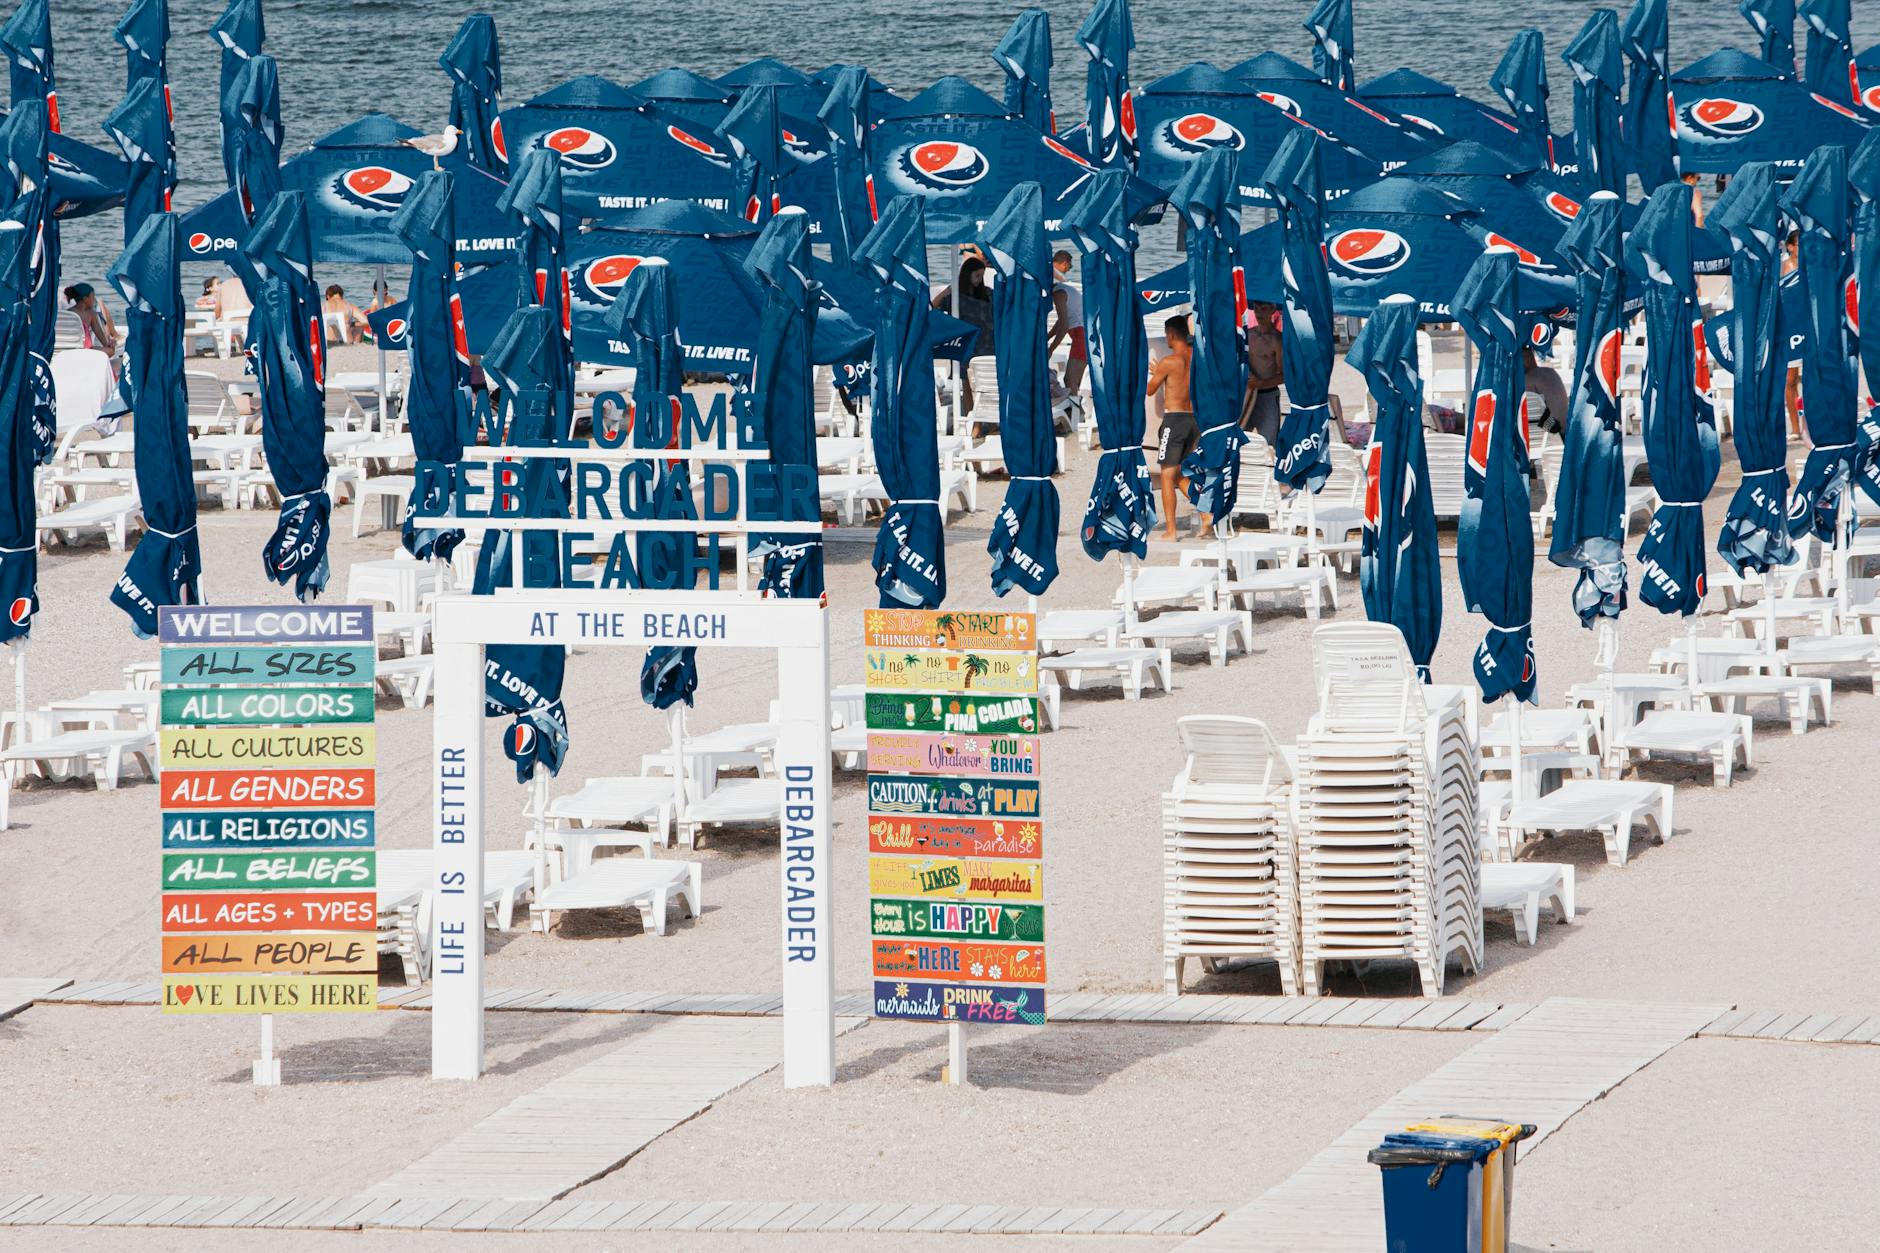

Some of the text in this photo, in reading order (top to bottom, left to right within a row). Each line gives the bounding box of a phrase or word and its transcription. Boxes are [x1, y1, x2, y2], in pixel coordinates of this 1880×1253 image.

[599, 196, 634, 208] TASTE
[472, 238, 504, 251] LOVE
[706, 346, 735, 360] LIVE
[735, 348, 751, 362] IT.
[454, 389, 769, 450] WELCOME
[1158, 427, 1171, 461] adidas
[414, 460, 820, 522] DEBARCADER
[522, 532, 720, 591] BEACH
[906, 551, 926, 572] IT.
[1027, 562, 1045, 582] IT.
[1661, 579, 1681, 599] IT.
[138, 597, 155, 615] IT.
[171, 611, 363, 637] WELCOME
[530, 612, 726, 639] AT THE BEACH
[956, 613, 1005, 635] START
[873, 634, 1016, 648] THINKING DRINKING
[180, 652, 357, 678] ALL SIZES
[889, 656, 1010, 673] no no no
[1480, 653, 1497, 676] IT.
[500, 670, 539, 705] LOVE
[868, 673, 908, 685] SHOES
[921, 671, 960, 683] SHIRT
[181, 694, 354, 719] ALL COLORS
[977, 698, 1033, 724] COLADA
[172, 736, 364, 760] ALL CULTURES
[929, 739, 1017, 769] Whatever YOU
[990, 757, 1032, 773] BRING
[172, 776, 364, 802] ALL GENDERS
[938, 790, 977, 813] drinks
[977, 783, 993, 800] at
[994, 789, 1038, 813] PLAY
[168, 818, 368, 842] ALL RELIGIONS
[870, 821, 914, 848] Chill
[974, 836, 1034, 854] paradise
[168, 857, 370, 882] ALL BELIEFS
[441, 748, 465, 974] LIFE IS BETTER
[785, 766, 816, 962] DEBARCADER
[920, 865, 961, 892] LIMES
[969, 872, 1032, 897] margaritas
[166, 901, 373, 924] ALL AGES + TYPES
[908, 904, 926, 930] is
[930, 904, 1002, 934] HAPPY
[173, 941, 365, 966] ALL PEOPLE
[966, 947, 1008, 964] STAYS
[236, 983, 299, 1007] LIVES
[311, 983, 370, 1006] HERE
[877, 987, 994, 1016] mermaids DRINK
[967, 1003, 1018, 1020] FREE
